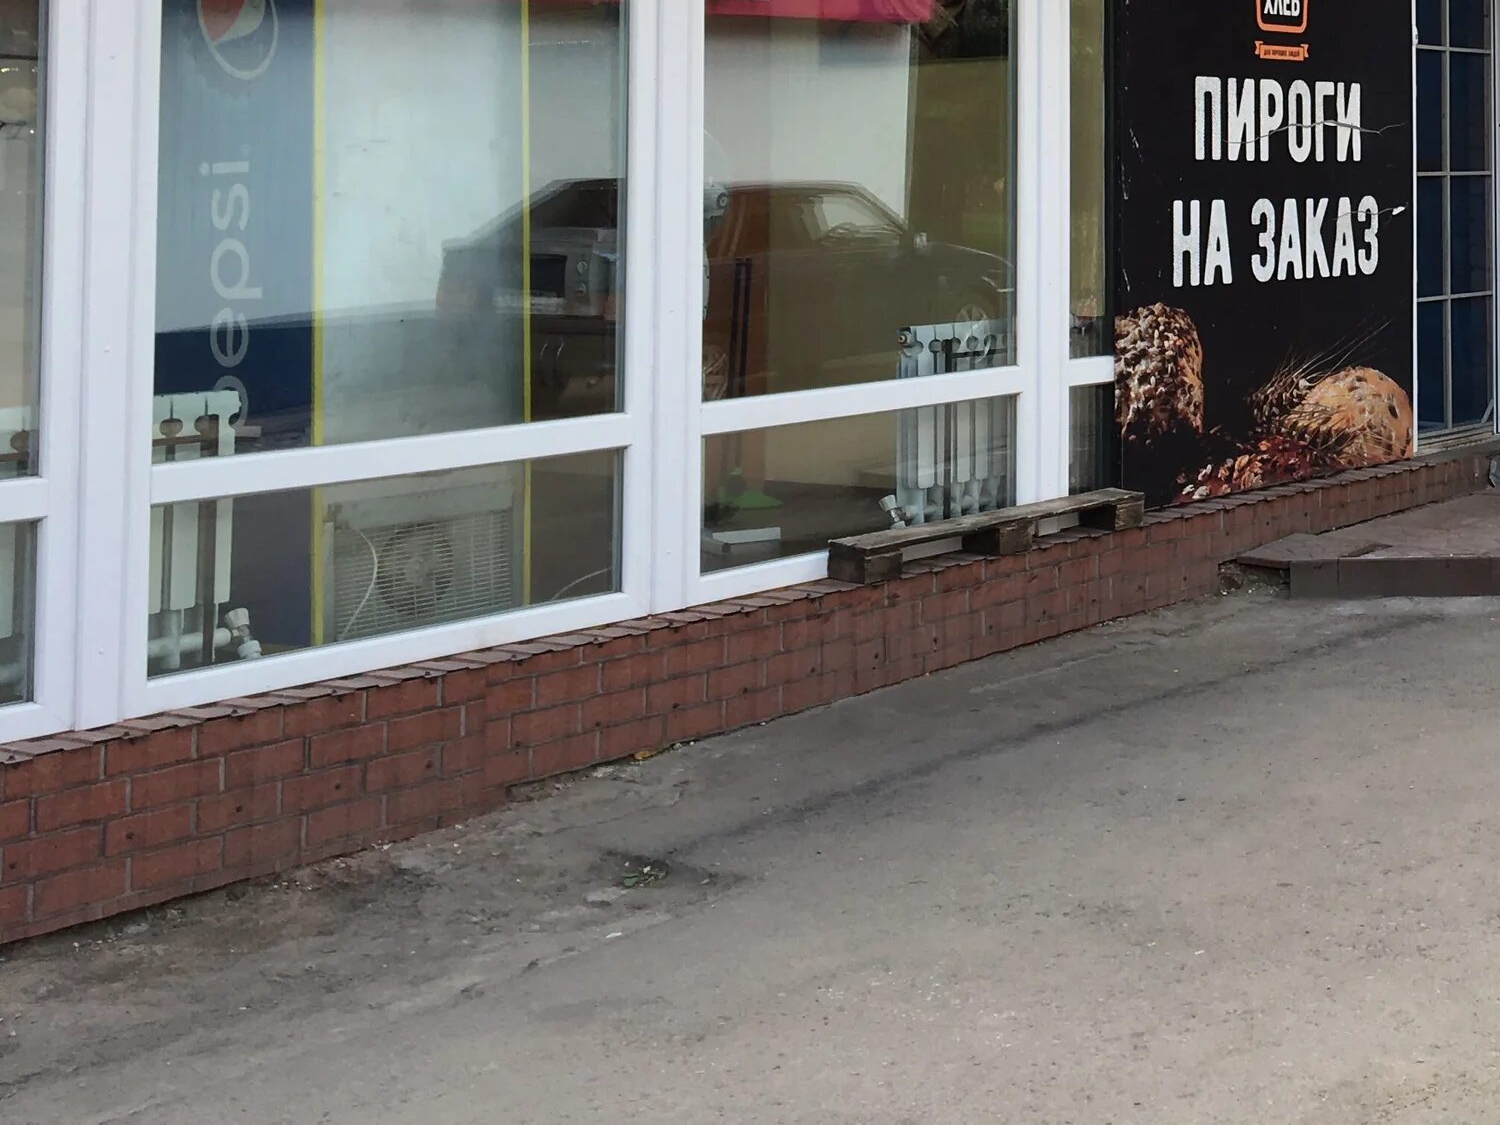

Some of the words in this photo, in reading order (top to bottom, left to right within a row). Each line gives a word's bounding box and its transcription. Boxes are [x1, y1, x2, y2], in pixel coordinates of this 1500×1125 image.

[1195, 76, 1362, 162] ПИРОГИ
[1172, 199, 1233, 288] НА
[1251, 195, 1380, 283] ЗАКАЗ
